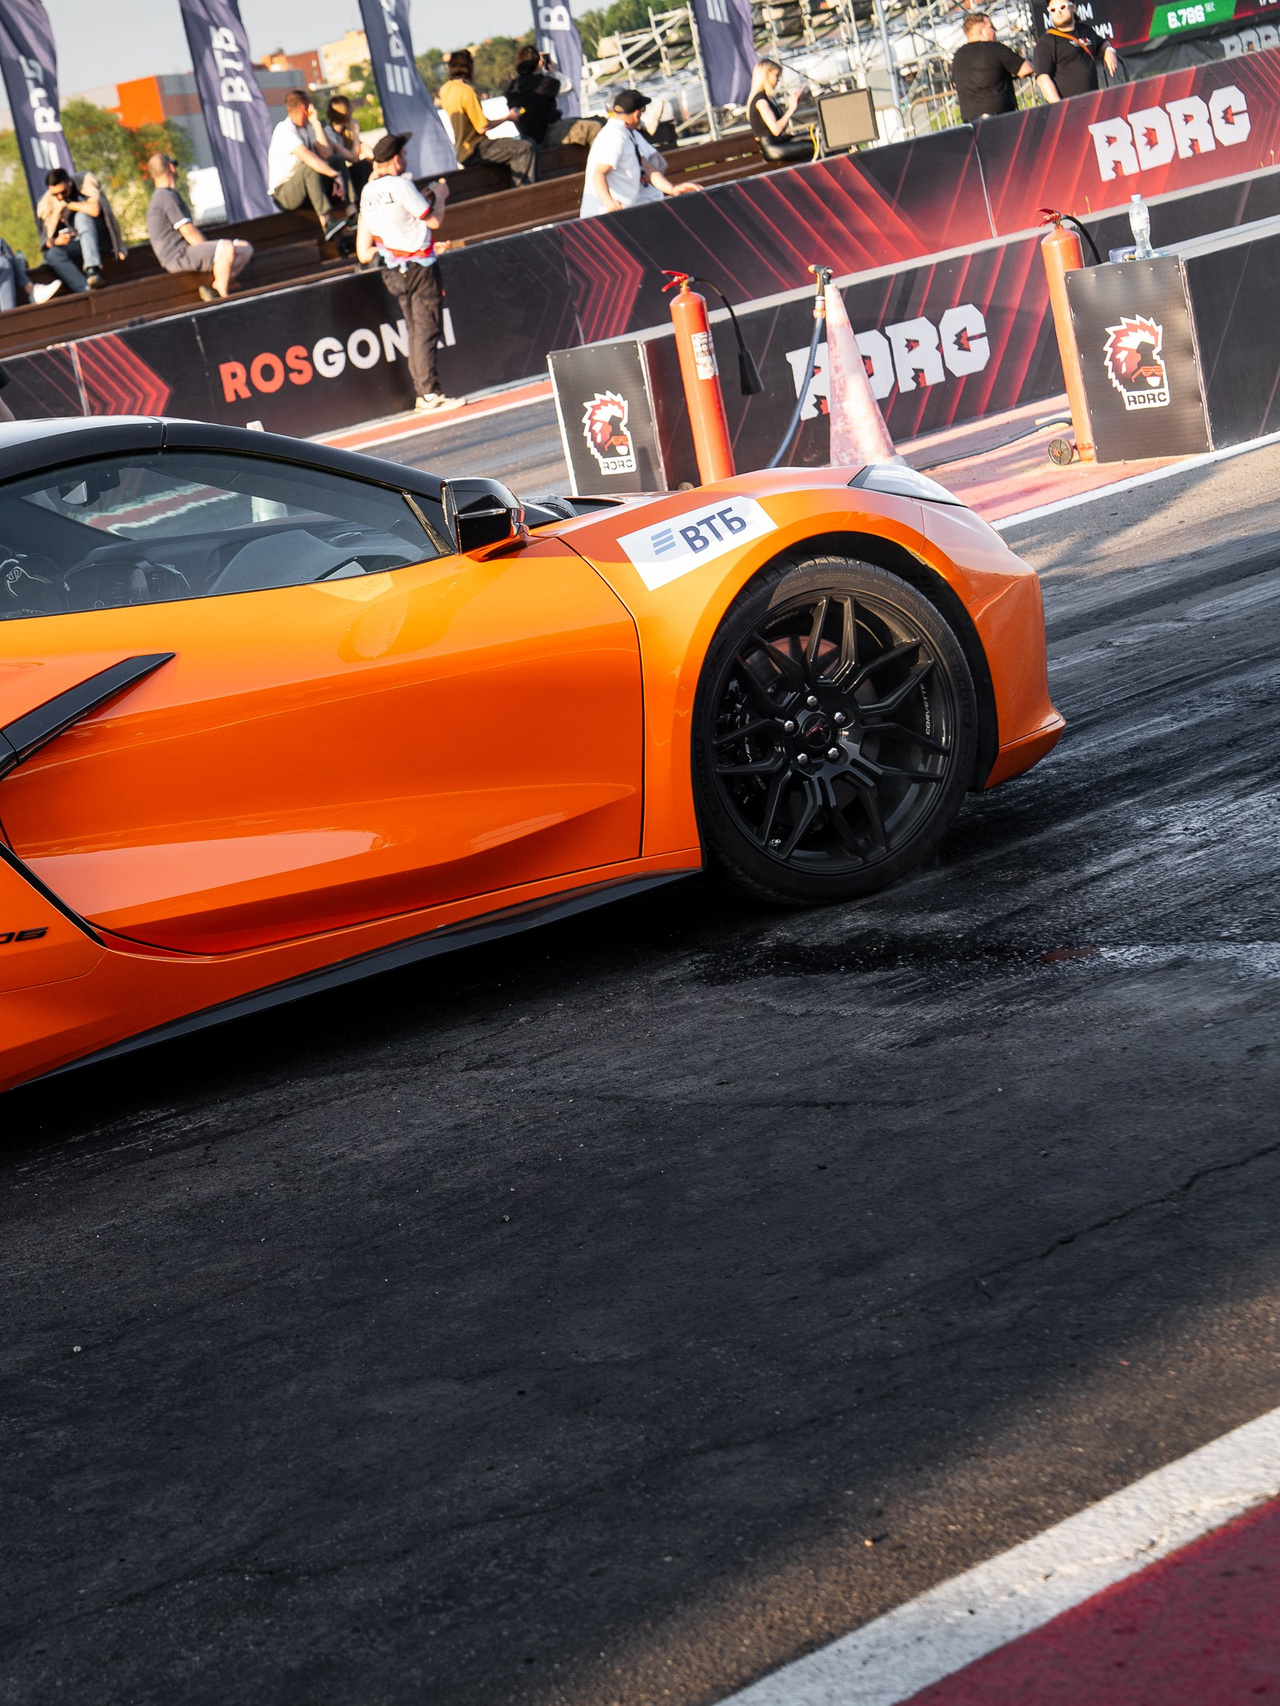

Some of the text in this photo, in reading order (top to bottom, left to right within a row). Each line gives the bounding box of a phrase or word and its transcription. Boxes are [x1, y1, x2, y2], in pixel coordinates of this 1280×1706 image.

[209, 25, 253, 103] ВТБ
[1219, 24, 1280, 60] RDR
[1088, 85, 1251, 182] RDRC
[219, 307, 456, 404] ROSGONI
[1126, 391, 1167, 407] RDRC
[602, 459, 633, 471] RDRC
[679, 506, 747, 554] ВТБ
